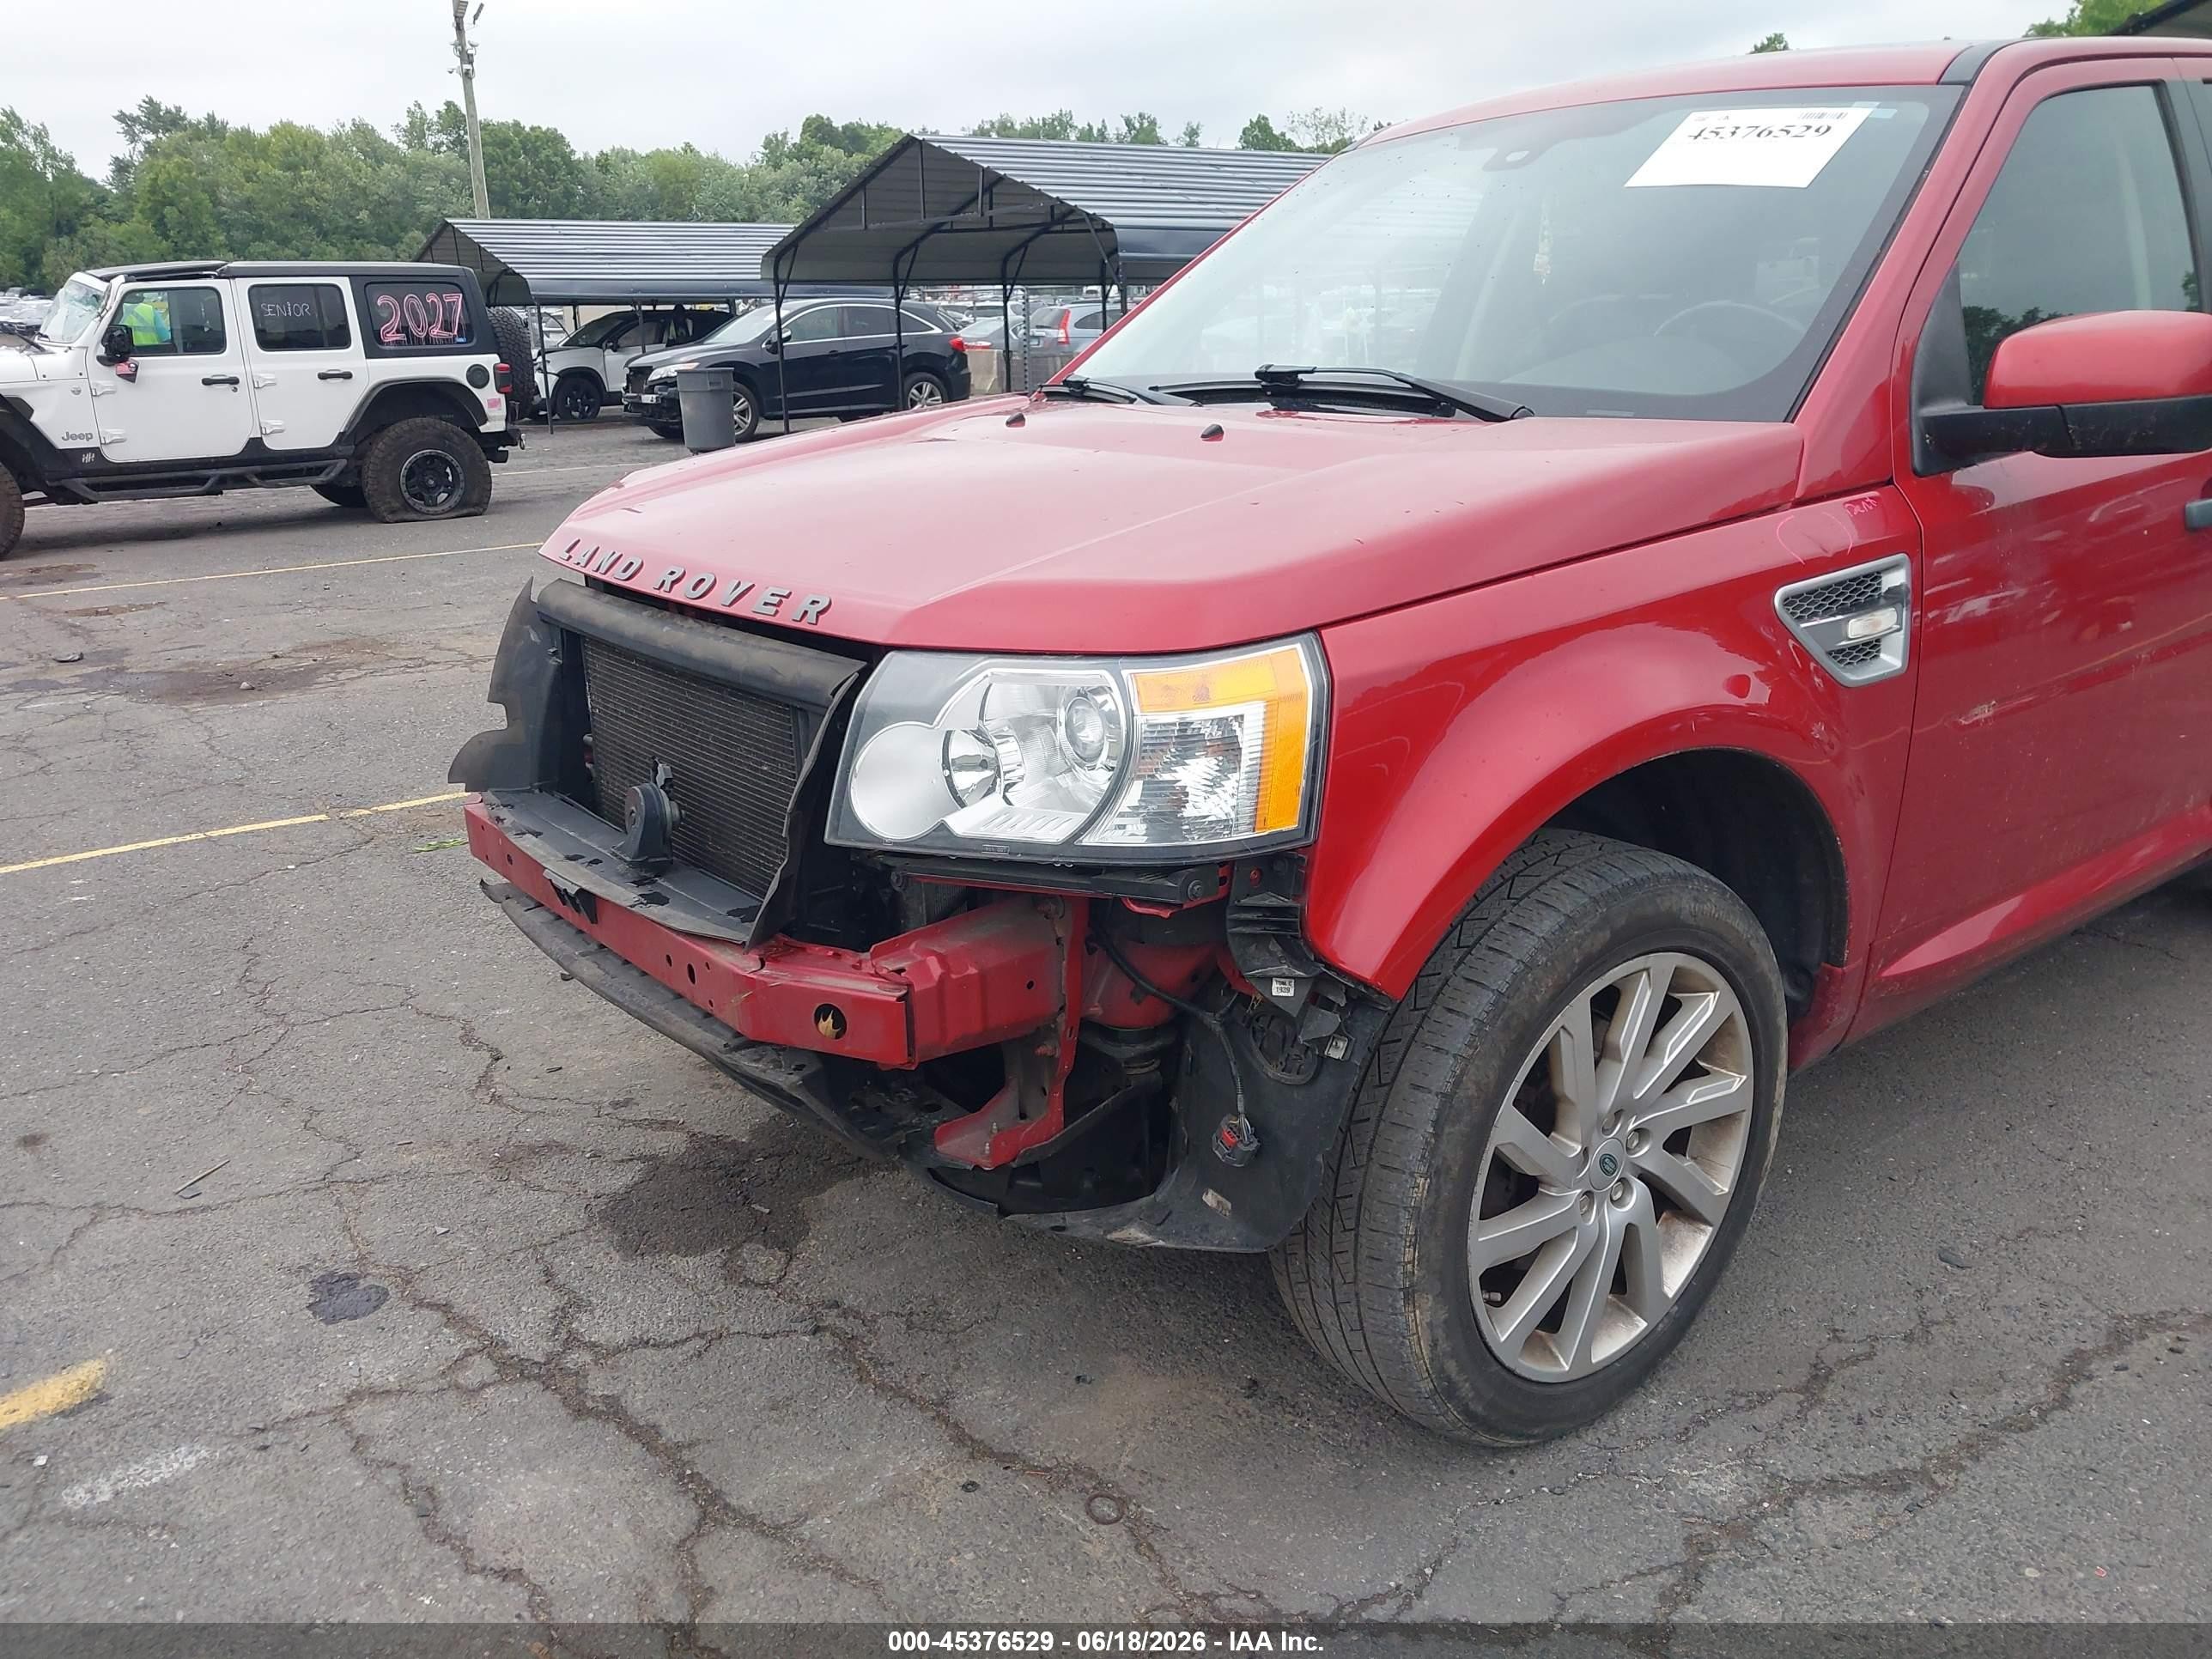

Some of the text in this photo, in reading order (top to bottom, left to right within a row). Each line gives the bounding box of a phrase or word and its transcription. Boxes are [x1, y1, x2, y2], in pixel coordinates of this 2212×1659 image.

[1687, 125, 1832, 140] 45376529
[377, 293, 463, 342] 2027
[61, 431, 94, 442] Jeep
[559, 538, 833, 626] LAND ROVER
